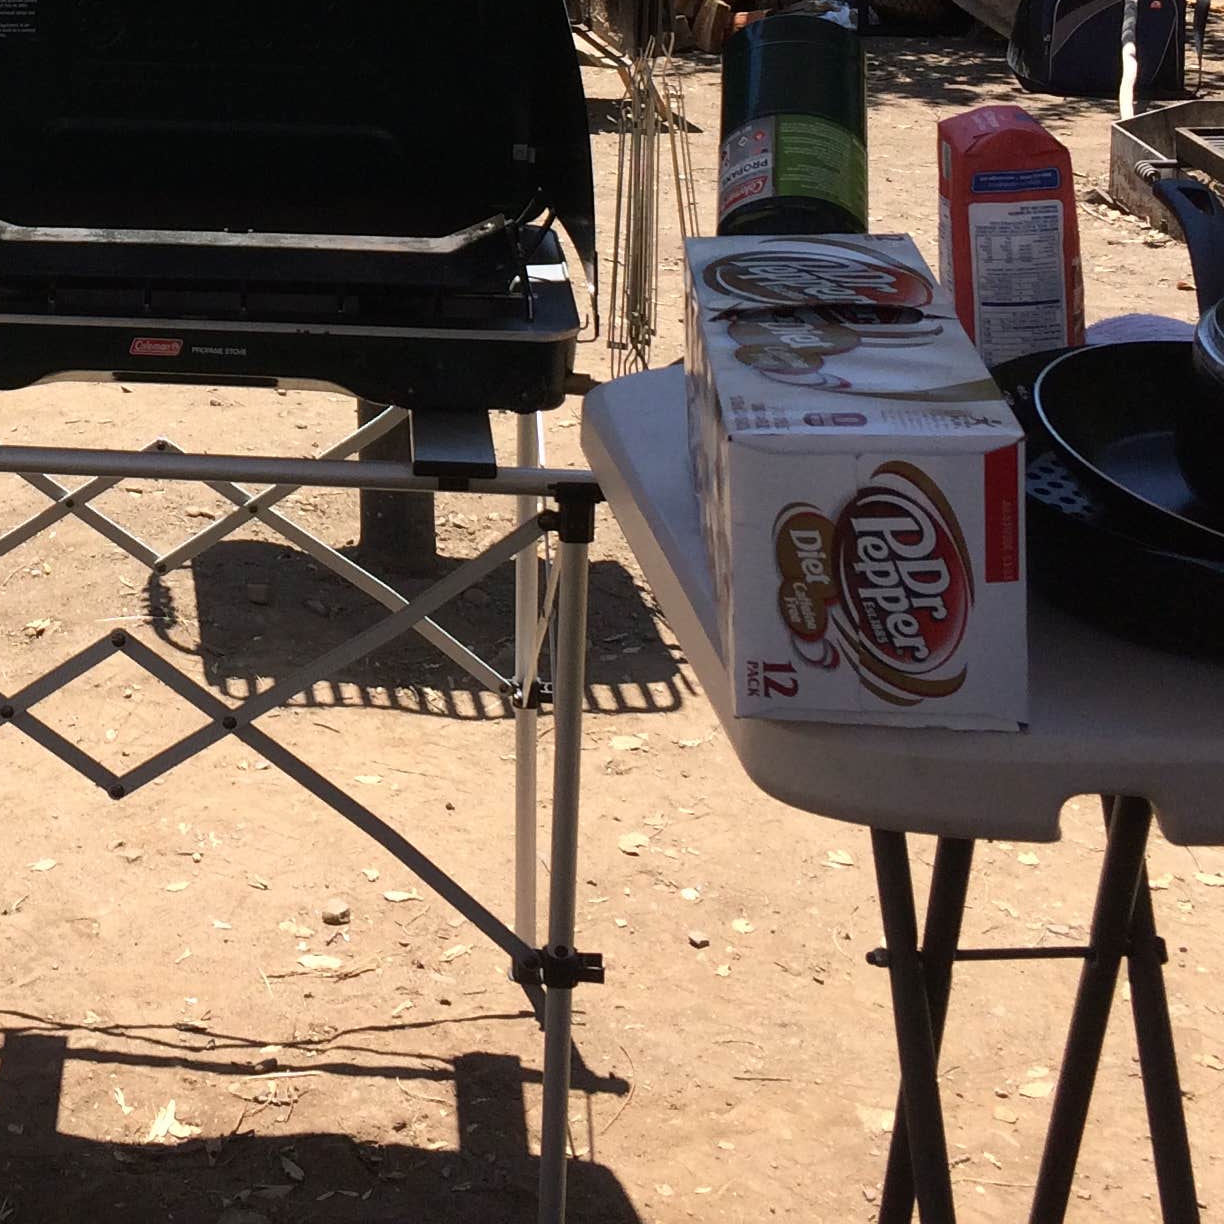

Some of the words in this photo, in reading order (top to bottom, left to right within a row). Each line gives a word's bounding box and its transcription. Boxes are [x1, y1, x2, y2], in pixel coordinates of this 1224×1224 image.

[135, 340, 180, 352] Coleman
[789, 528, 831, 585] Diet
[792, 581, 819, 630] Caffeine
[849, 504, 936, 661] Pepper
[895, 558, 951, 620] Dr
[747, 660, 760, 697] PACK
[762, 660, 799, 700] 12
